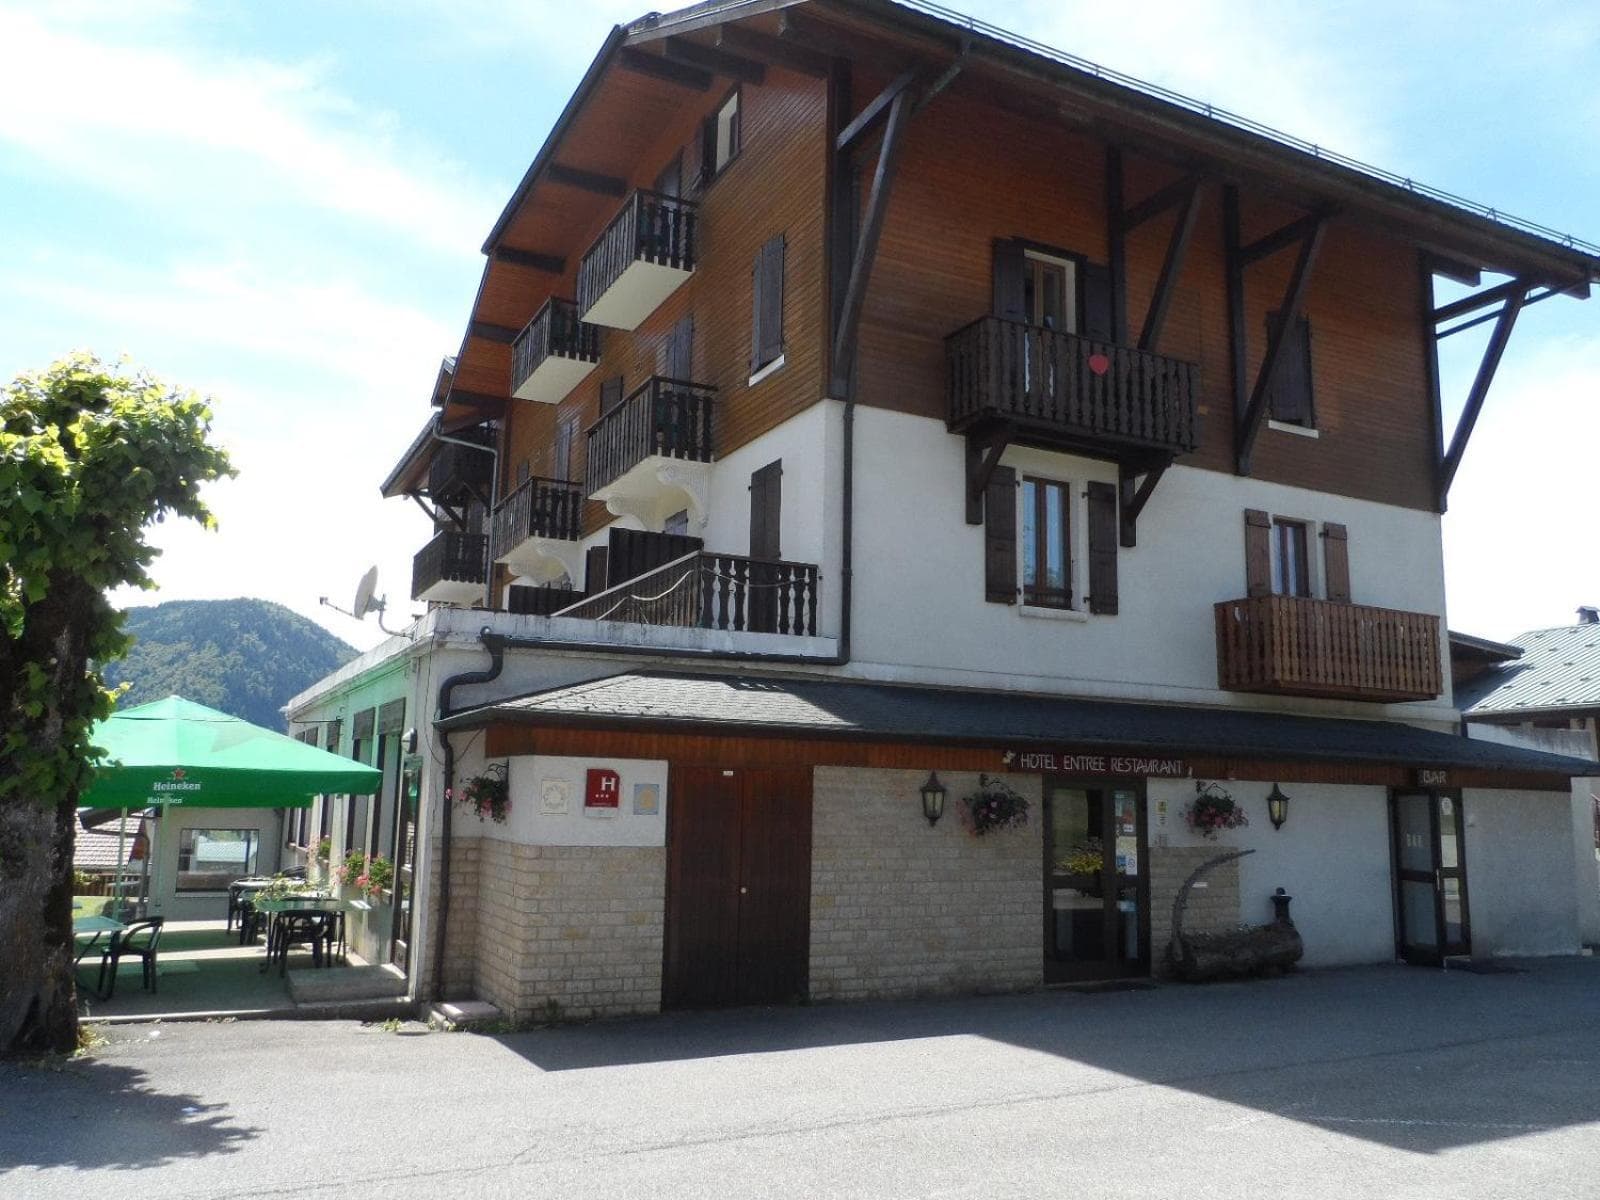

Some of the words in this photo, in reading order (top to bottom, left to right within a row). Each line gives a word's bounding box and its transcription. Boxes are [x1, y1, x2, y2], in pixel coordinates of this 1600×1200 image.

[1020, 753, 1057, 770] HOTEL
[1063, 754, 1106, 772] ENTREE
[1111, 757, 1183, 775] RESTAURANT
[601, 777, 617, 791] H
[1423, 769, 1447, 785] BAR
[153, 781, 201, 791] Heineken
